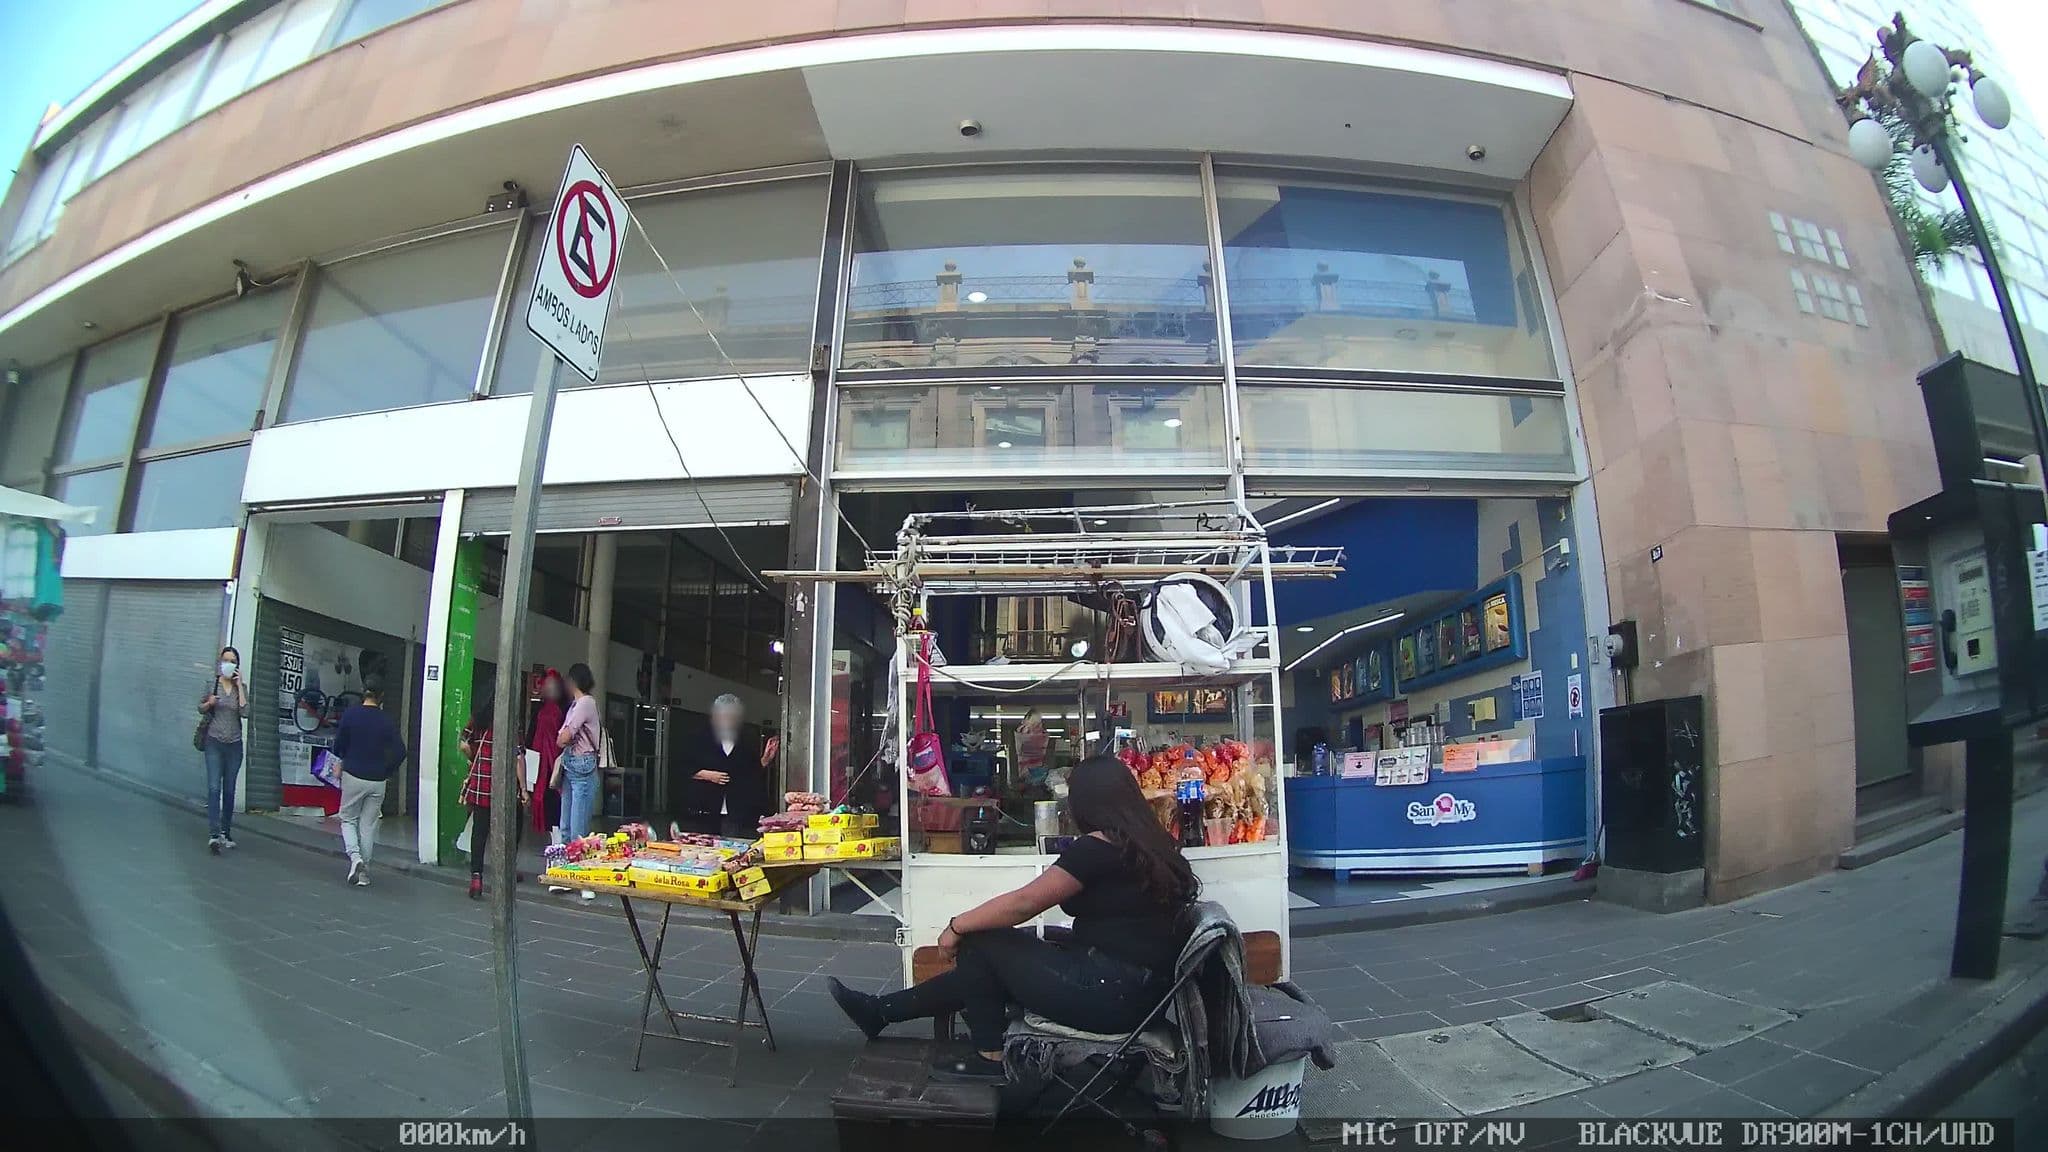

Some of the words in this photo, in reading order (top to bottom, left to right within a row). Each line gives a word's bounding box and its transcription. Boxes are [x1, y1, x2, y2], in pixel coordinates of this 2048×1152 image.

[536, 283, 570, 329] AMBOS
[569, 314, 600, 356] LADOS
[1410, 804, 1435, 817] San
[1454, 802, 1472, 818] My
[671, 876, 690, 887] Rosa
